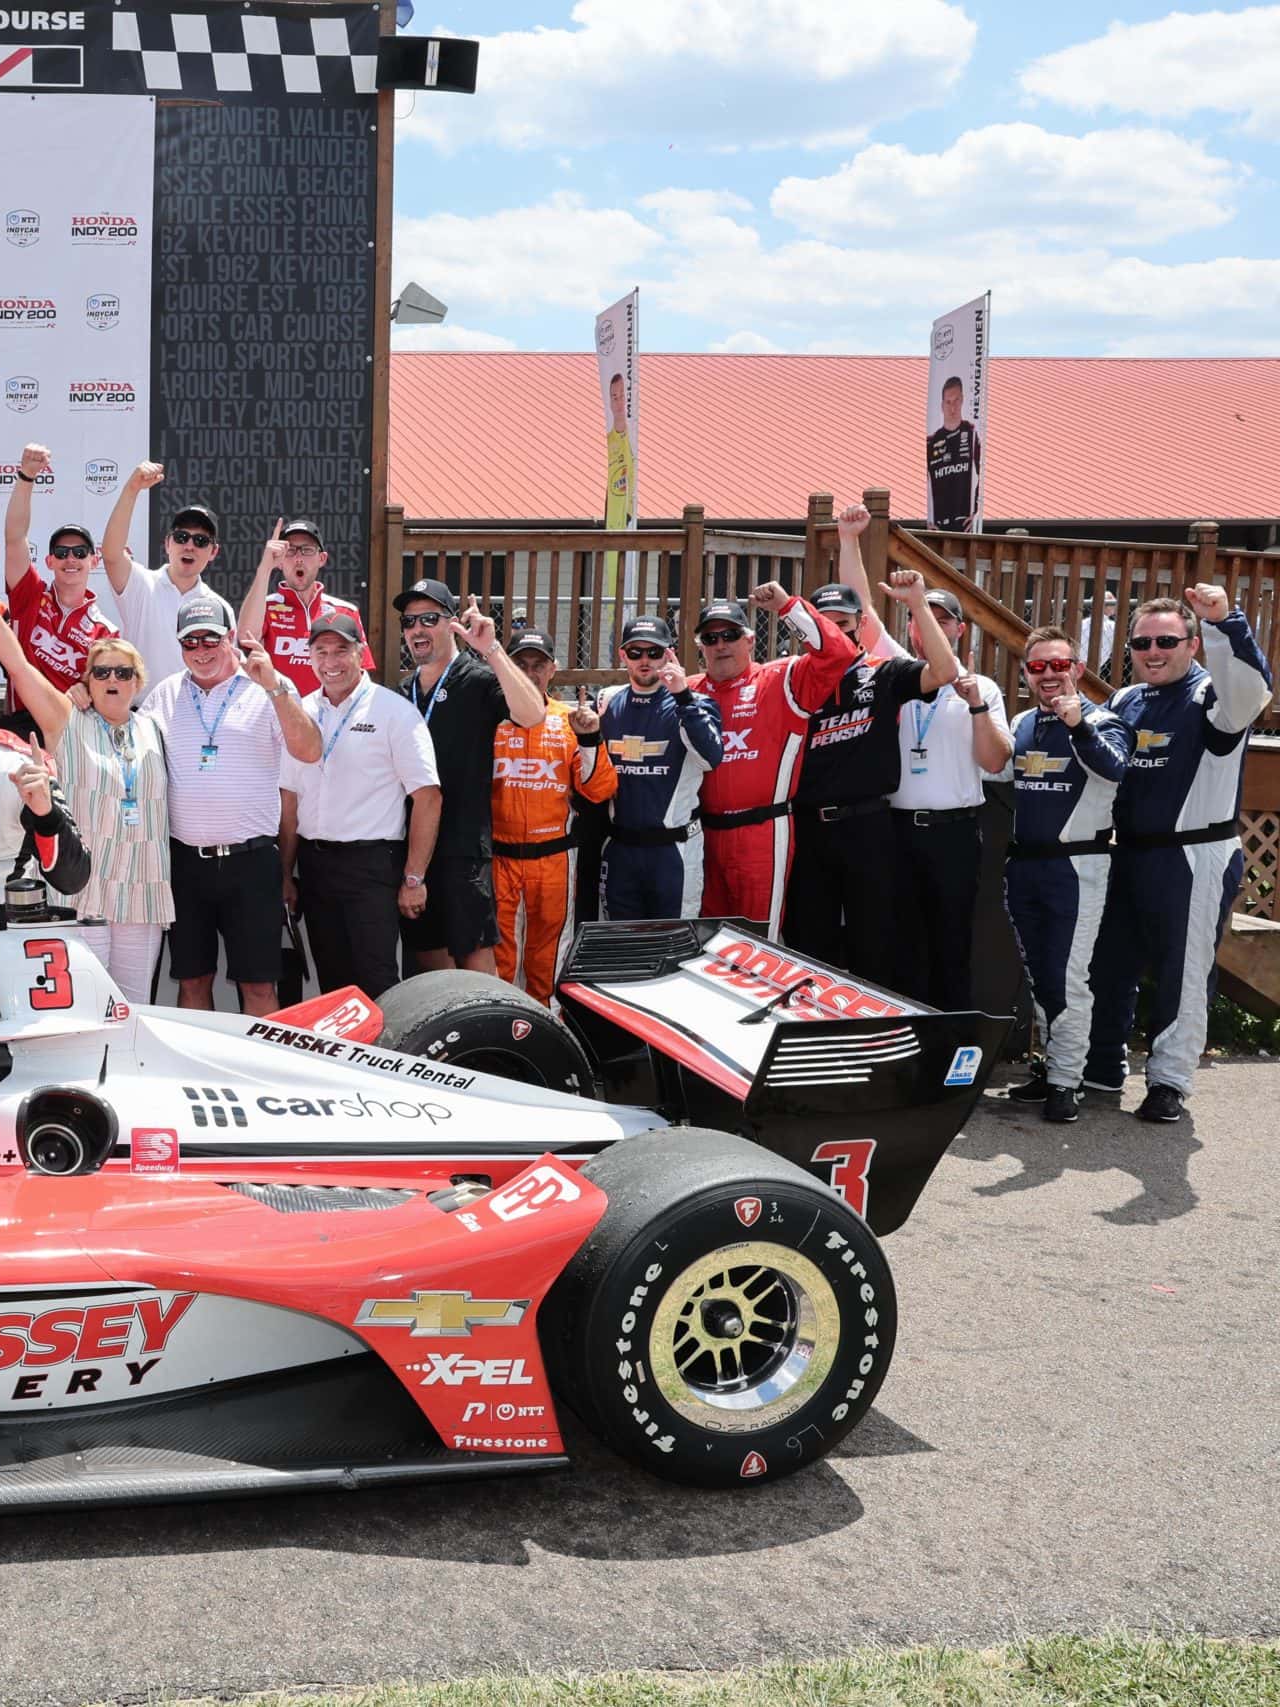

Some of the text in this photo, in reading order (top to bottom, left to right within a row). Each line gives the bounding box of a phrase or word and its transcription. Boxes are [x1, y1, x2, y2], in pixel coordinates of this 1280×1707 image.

[72, 216, 137, 226] HONDA
[72, 226, 138, 237] INDY 200
[27, 310, 56, 320] 200
[973, 309, 984, 419] NEWGARDEN
[934, 462, 969, 479] HITACHI
[30, 624, 89, 671] DEX
[819, 707, 871, 731] TEAM
[505, 780, 567, 793] imaging
[24, 938, 75, 1011] 3
[246, 1022, 476, 1092] PENSKE Truck Rental
[256, 1092, 453, 1126] carshop
[134, 1164, 176, 1172] Speedway
[810, 1138, 878, 1221] 3
[824, 1230, 880, 1422] Firestone
[418, 1354, 533, 1385] XPEL
[616, 1263, 677, 1453] Firestone
[518, 1406, 545, 1416] NTT
[749, 1403, 800, 1430] RACING
[453, 1435, 549, 1449] Firestone
